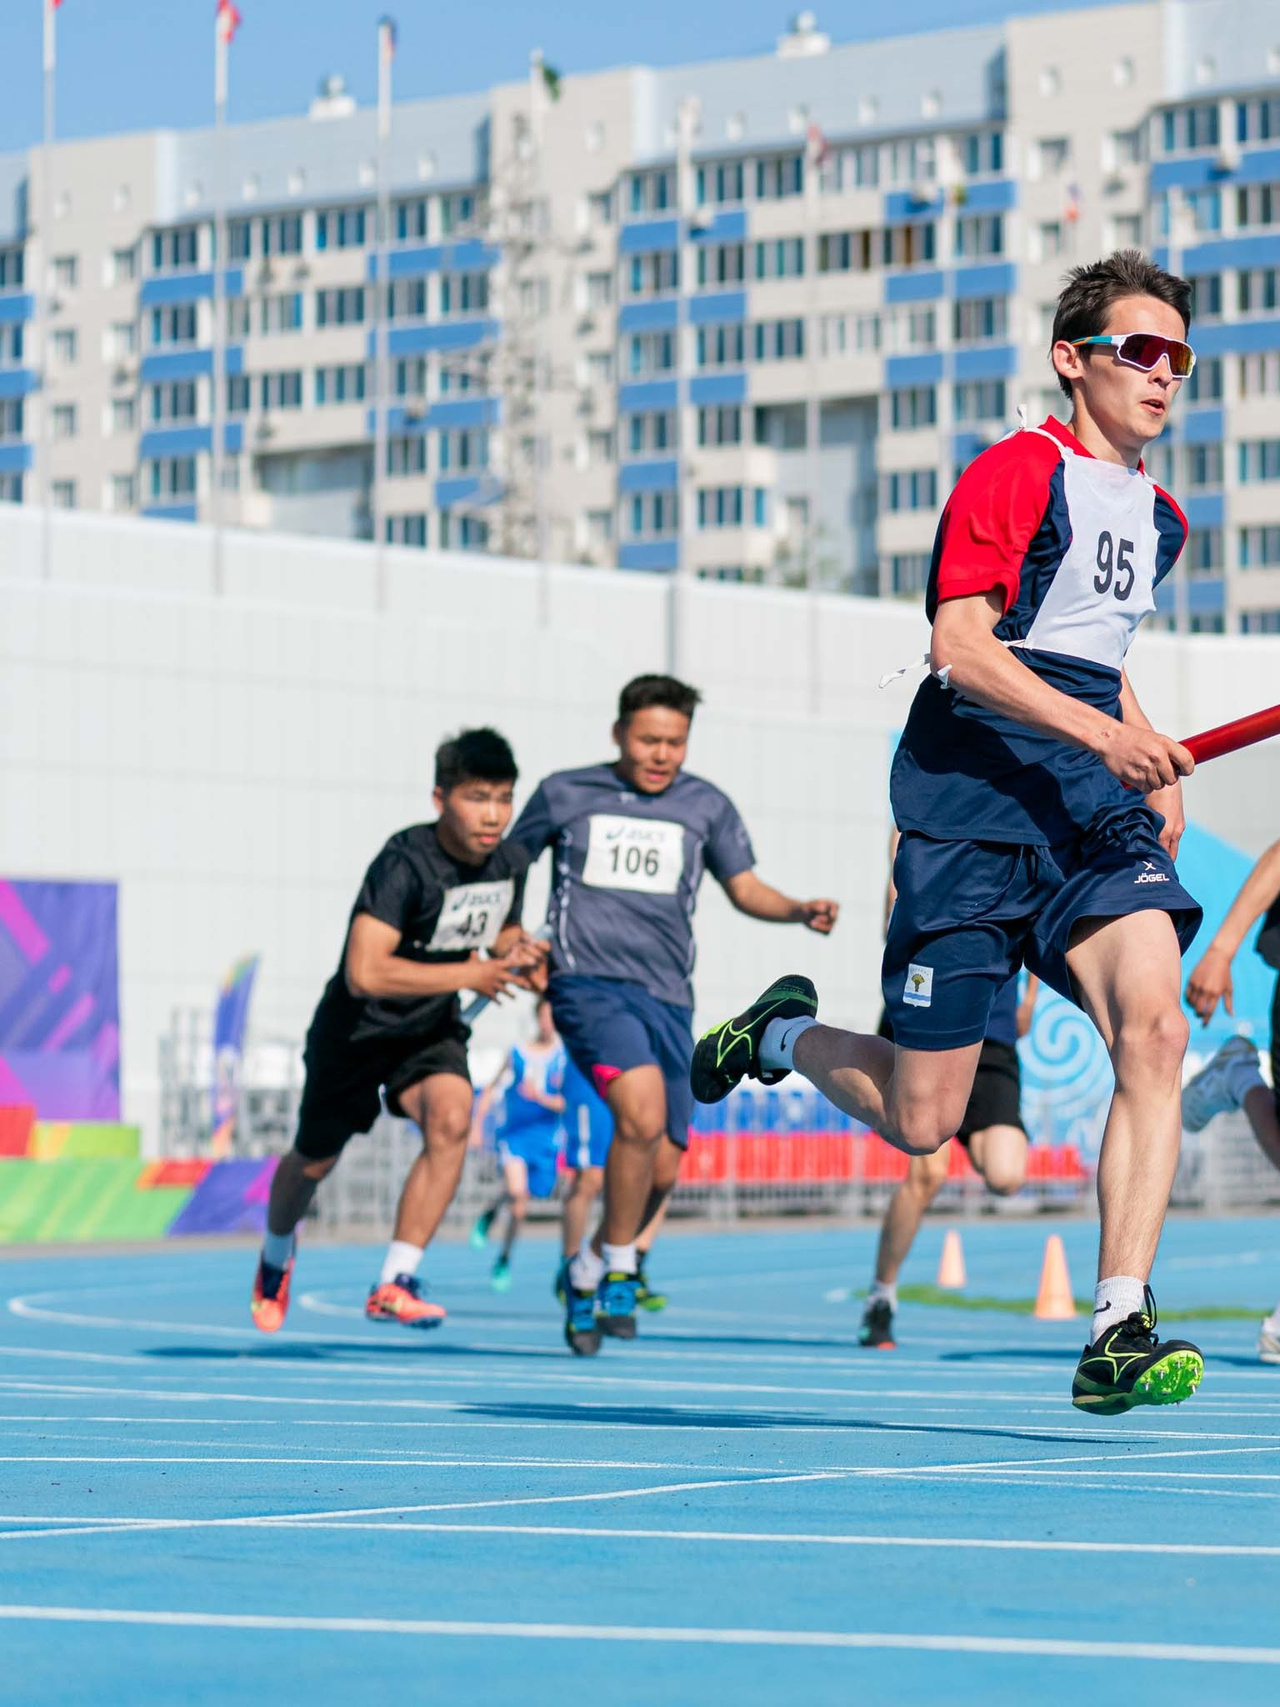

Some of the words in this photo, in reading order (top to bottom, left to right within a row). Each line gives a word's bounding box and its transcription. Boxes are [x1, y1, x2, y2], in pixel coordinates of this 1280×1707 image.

[1093, 530, 1135, 601] 95
[609, 844, 659, 877] 106
[1133, 872, 1170, 884] JÖGEL
[456, 911, 489, 938] 43
